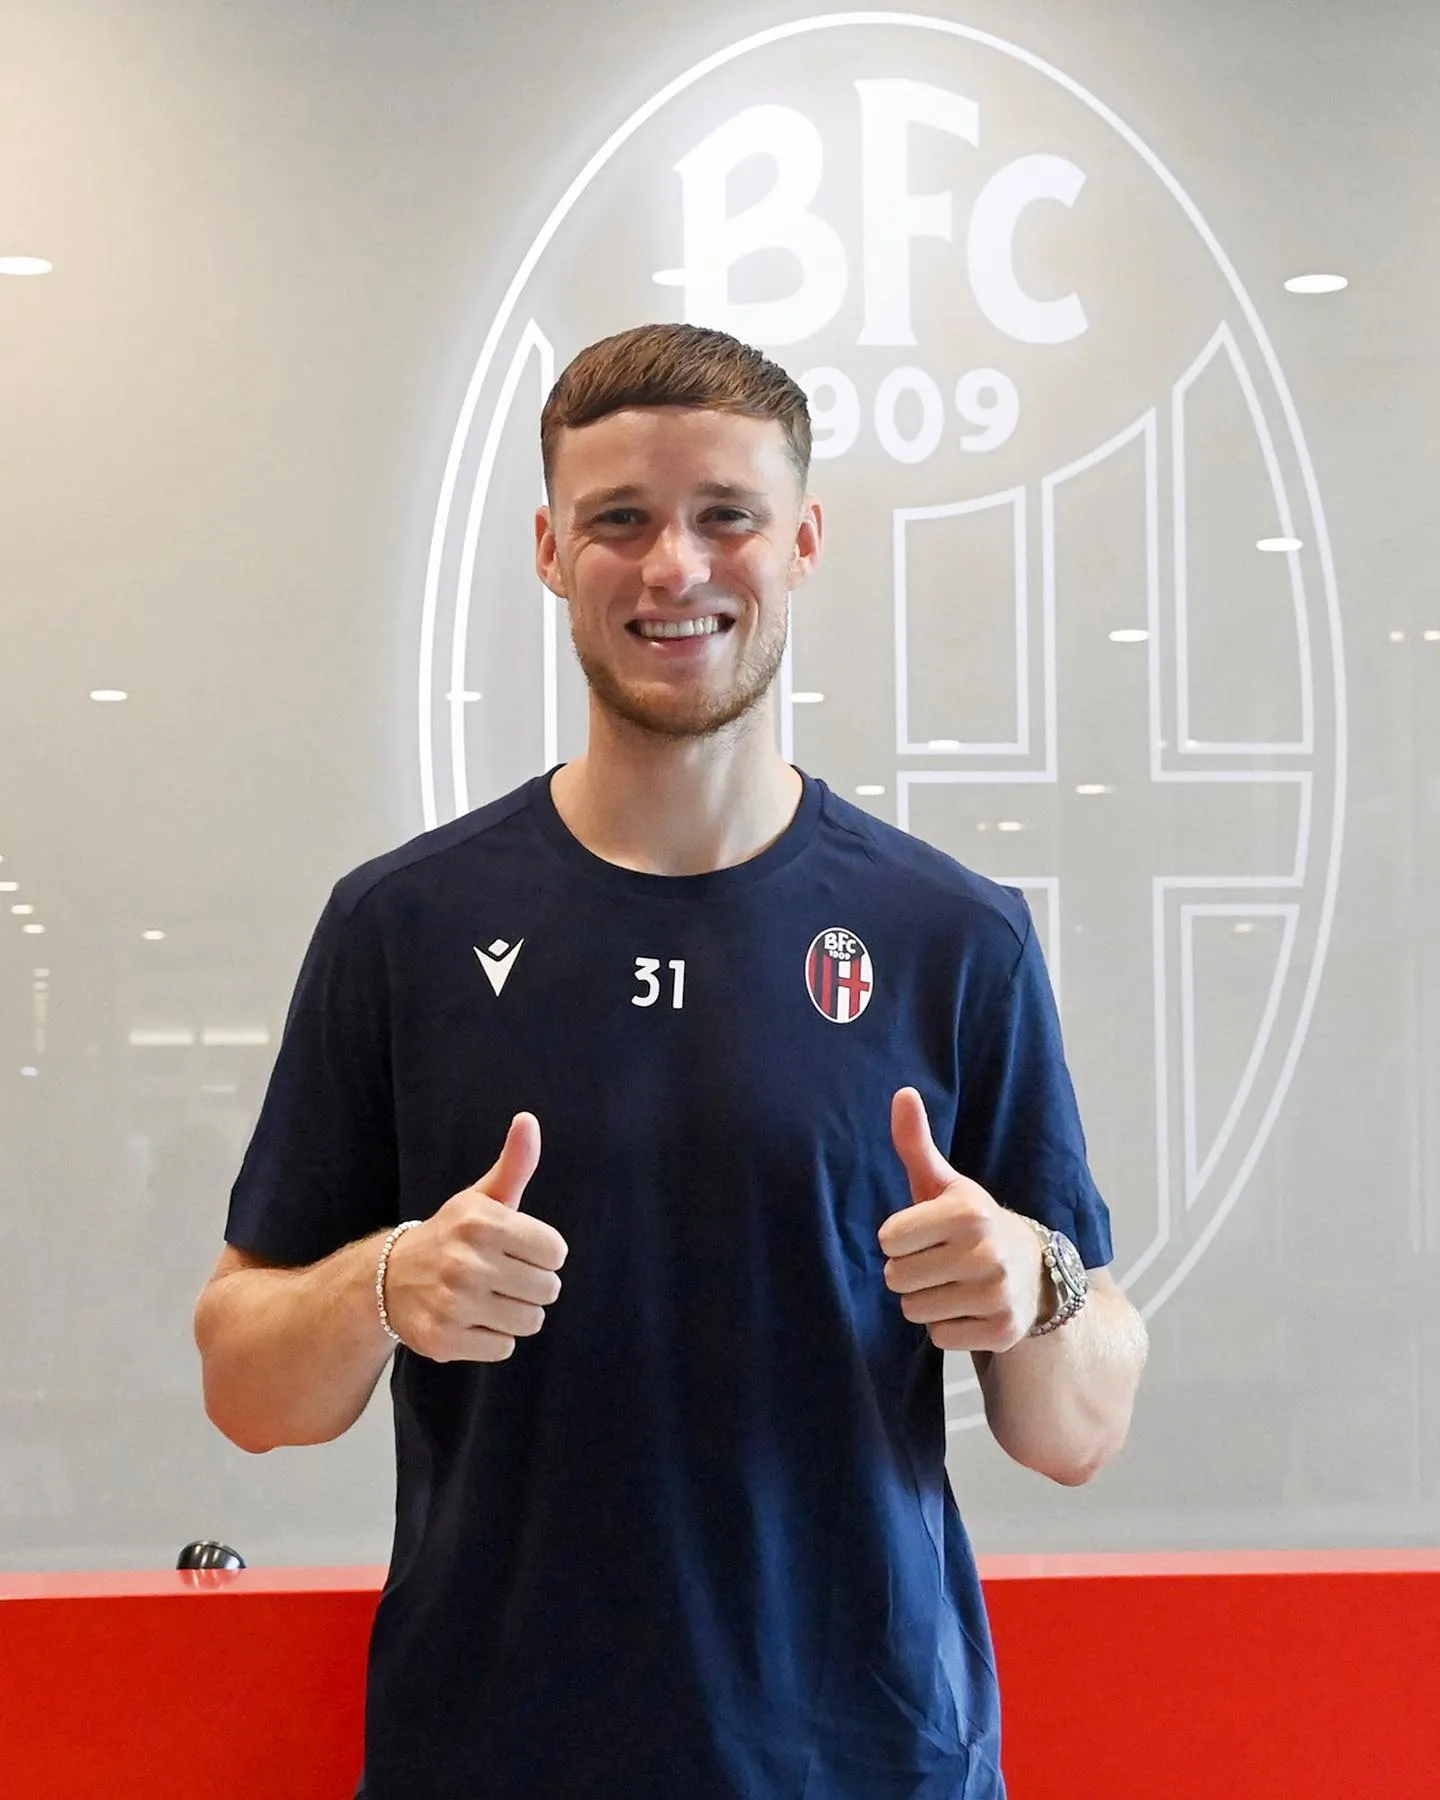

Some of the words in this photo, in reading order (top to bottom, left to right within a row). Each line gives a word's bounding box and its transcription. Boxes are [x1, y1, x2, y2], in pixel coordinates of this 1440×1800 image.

[672, 78, 1089, 347] BFC
[798, 366, 1020, 464] 909
[824, 932, 857, 954] BFC
[631, 957, 685, 1009] 31
